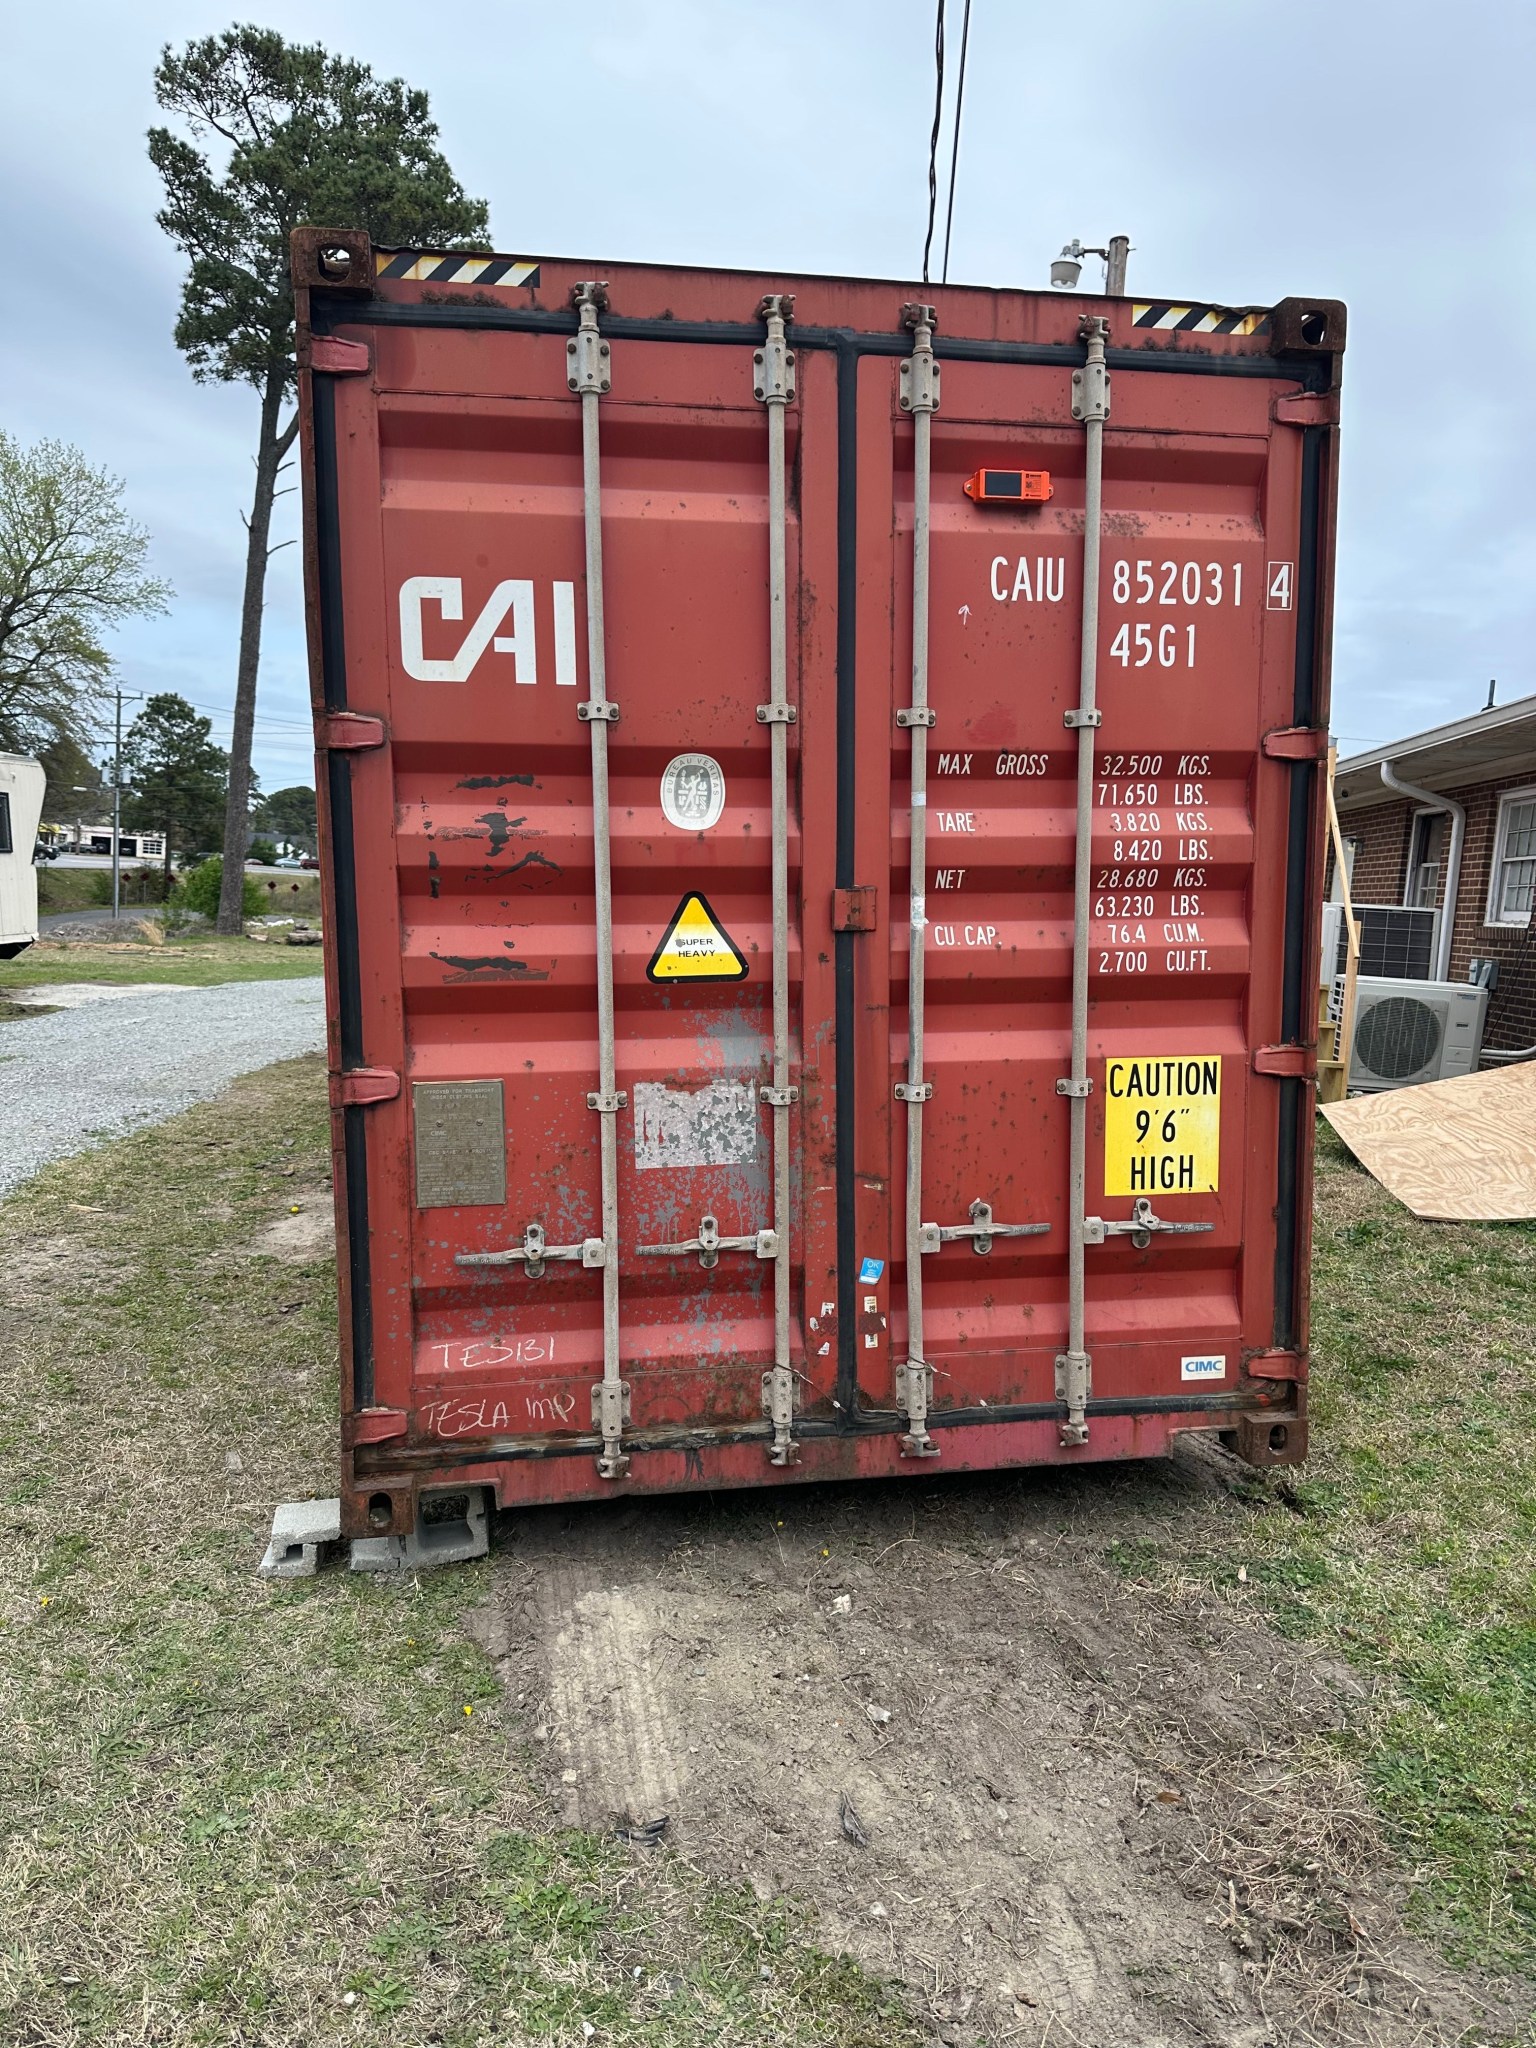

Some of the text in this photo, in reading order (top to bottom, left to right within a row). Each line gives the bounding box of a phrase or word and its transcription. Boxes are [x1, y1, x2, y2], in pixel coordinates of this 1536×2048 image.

[990, 556, 1290, 608] CAIU 852031 4
[399, 576, 577, 685] CAI
[1109, 623, 1196, 667] 45G1
[666, 757, 719, 795] BUREAU VERITAS
[937, 753, 973, 775] MAX
[995, 754, 1049, 775] GROSS
[1177, 755, 1212, 776] KGS.
[1098, 783, 1209, 805] 71,650 LBS.
[936, 812, 976, 832] TARE
[1175, 812, 1213, 831] KGS.
[1113, 839, 1214, 861] 8,420 LBS.
[935, 868, 1208, 889] NET 28,680 KGS.
[1095, 894, 1205, 917] 63,230 LBS.
[679, 938, 713, 947] SUPER
[1107, 924, 1146, 943] 76.4
[1163, 923, 1205, 943] CU.M.
[678, 949, 716, 958] HEAVY
[1099, 950, 1212, 973] 2,700 CU.FT.
[1109, 1061, 1217, 1098] CAUTION
[1130, 1154, 1194, 1190] HIGH
[867, 1260, 880, 1269] OK
[1185, 1360, 1222, 1373] CIMC
[420, 1398, 518, 1437] TESLA
